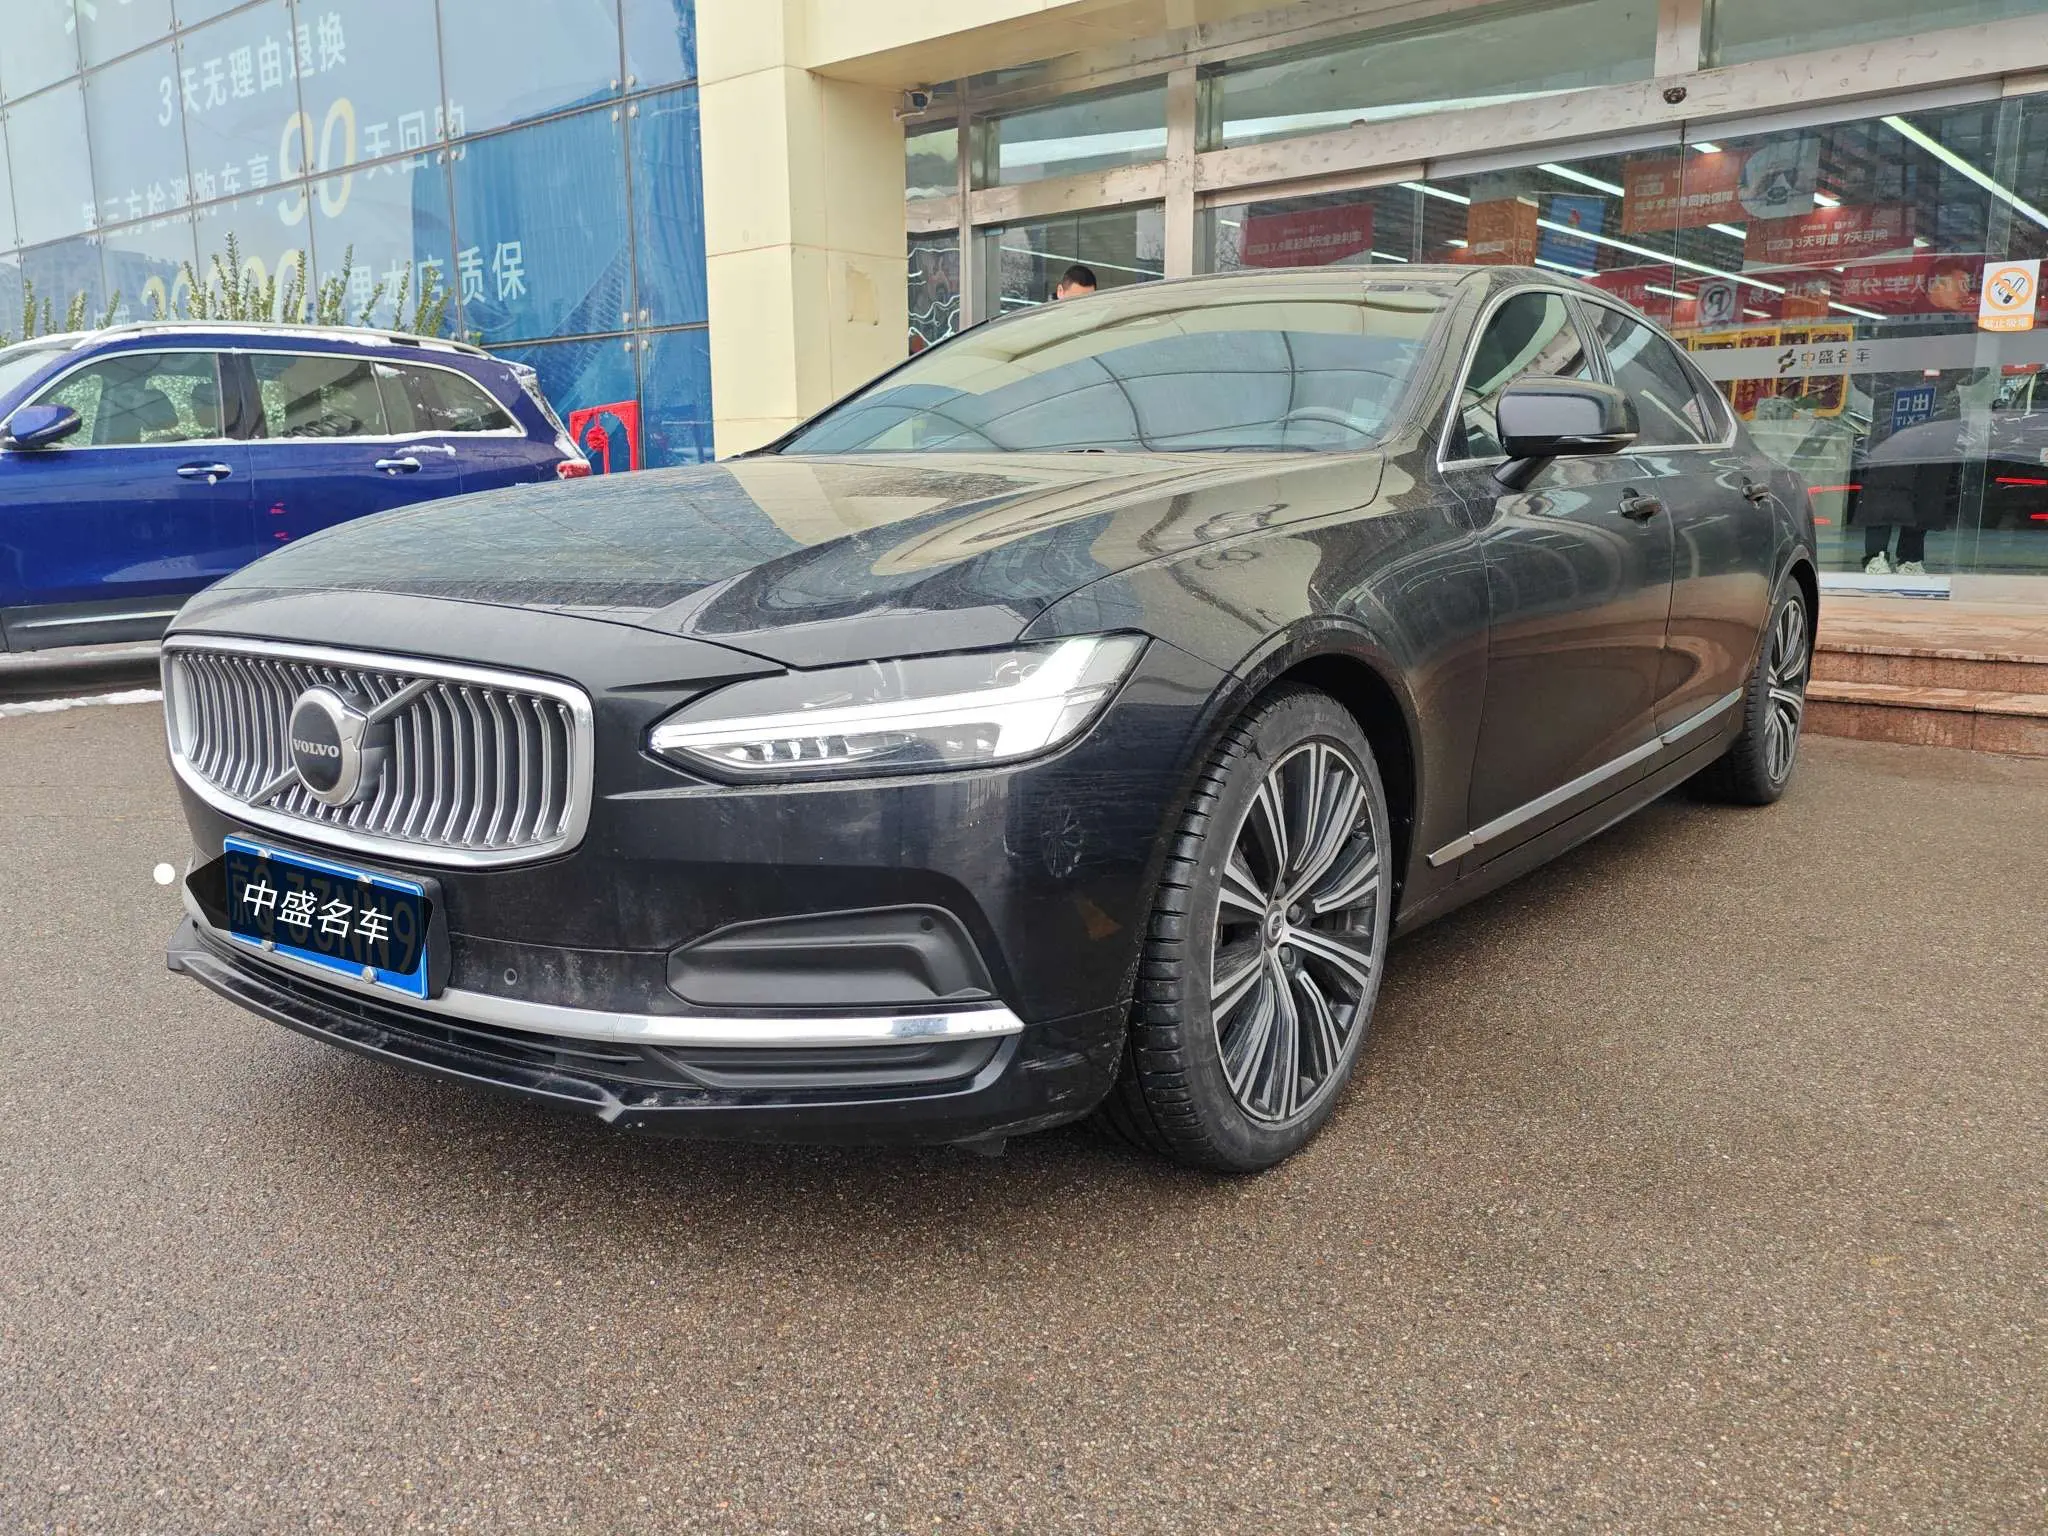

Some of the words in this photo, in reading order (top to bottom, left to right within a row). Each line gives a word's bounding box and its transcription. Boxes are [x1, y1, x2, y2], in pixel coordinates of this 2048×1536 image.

[157, 11, 346, 127] 3天无理由退换
[1801, 348, 1872, 368] 中盛名车
[292, 738, 340, 758] VOLVO
